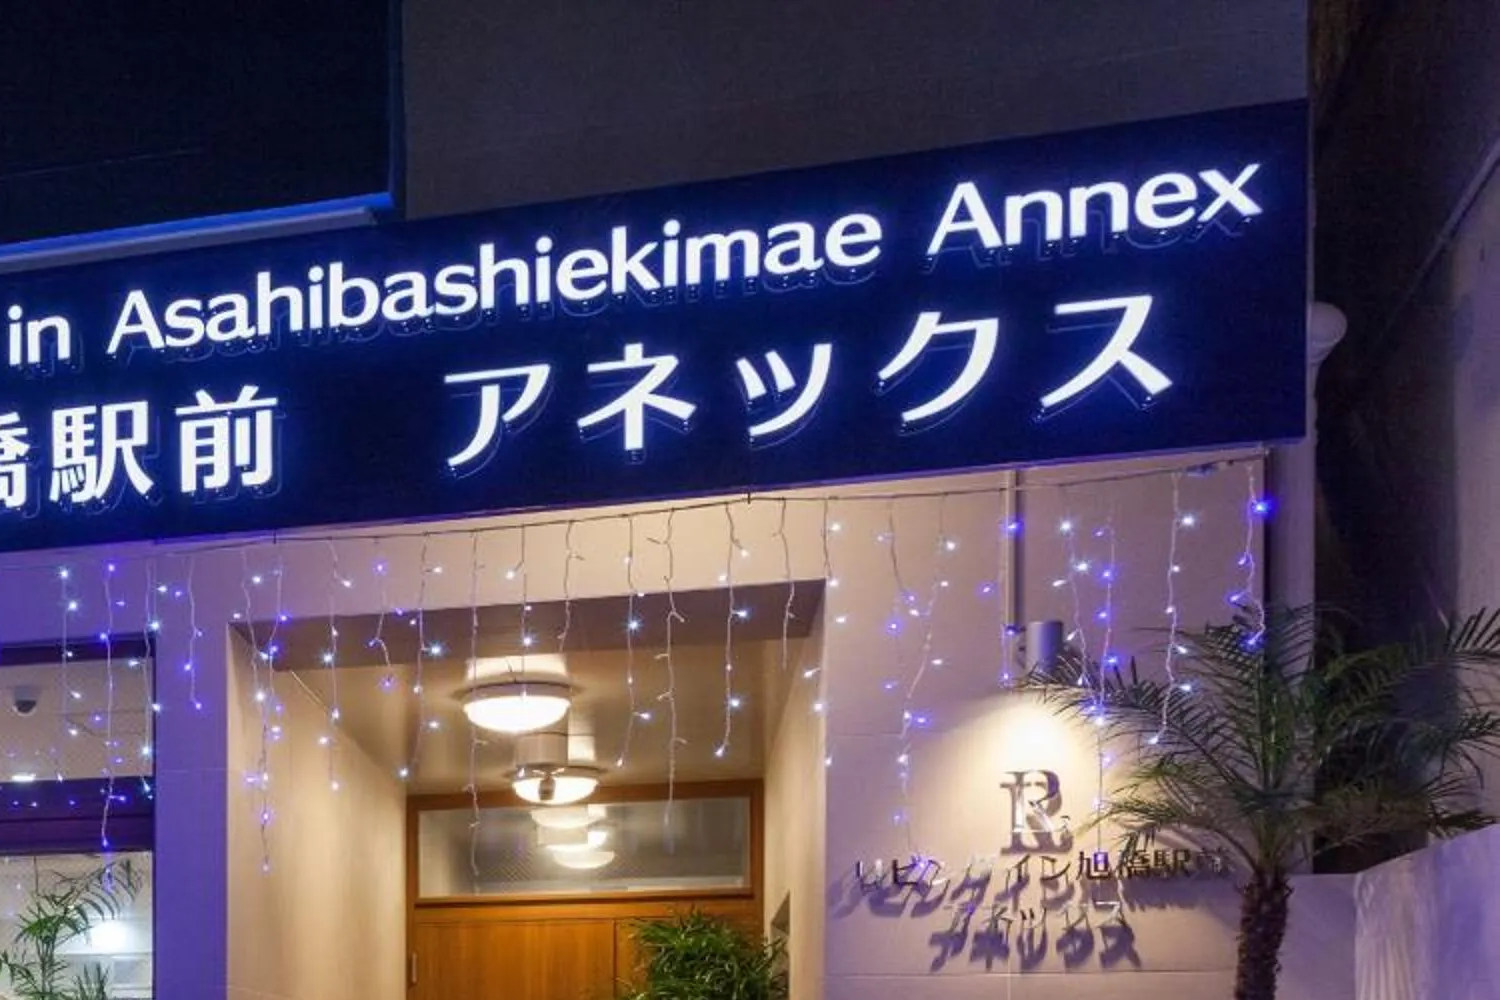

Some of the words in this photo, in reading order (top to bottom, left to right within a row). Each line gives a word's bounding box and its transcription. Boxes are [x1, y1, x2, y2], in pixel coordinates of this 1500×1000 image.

[8, 304, 70, 366] in
[107, 213, 882, 354] Asahibashiekimae
[927, 164, 1262, 254] Annex
[445, 295, 1173, 468] アネックス
[1002, 769, 1071, 834] R
